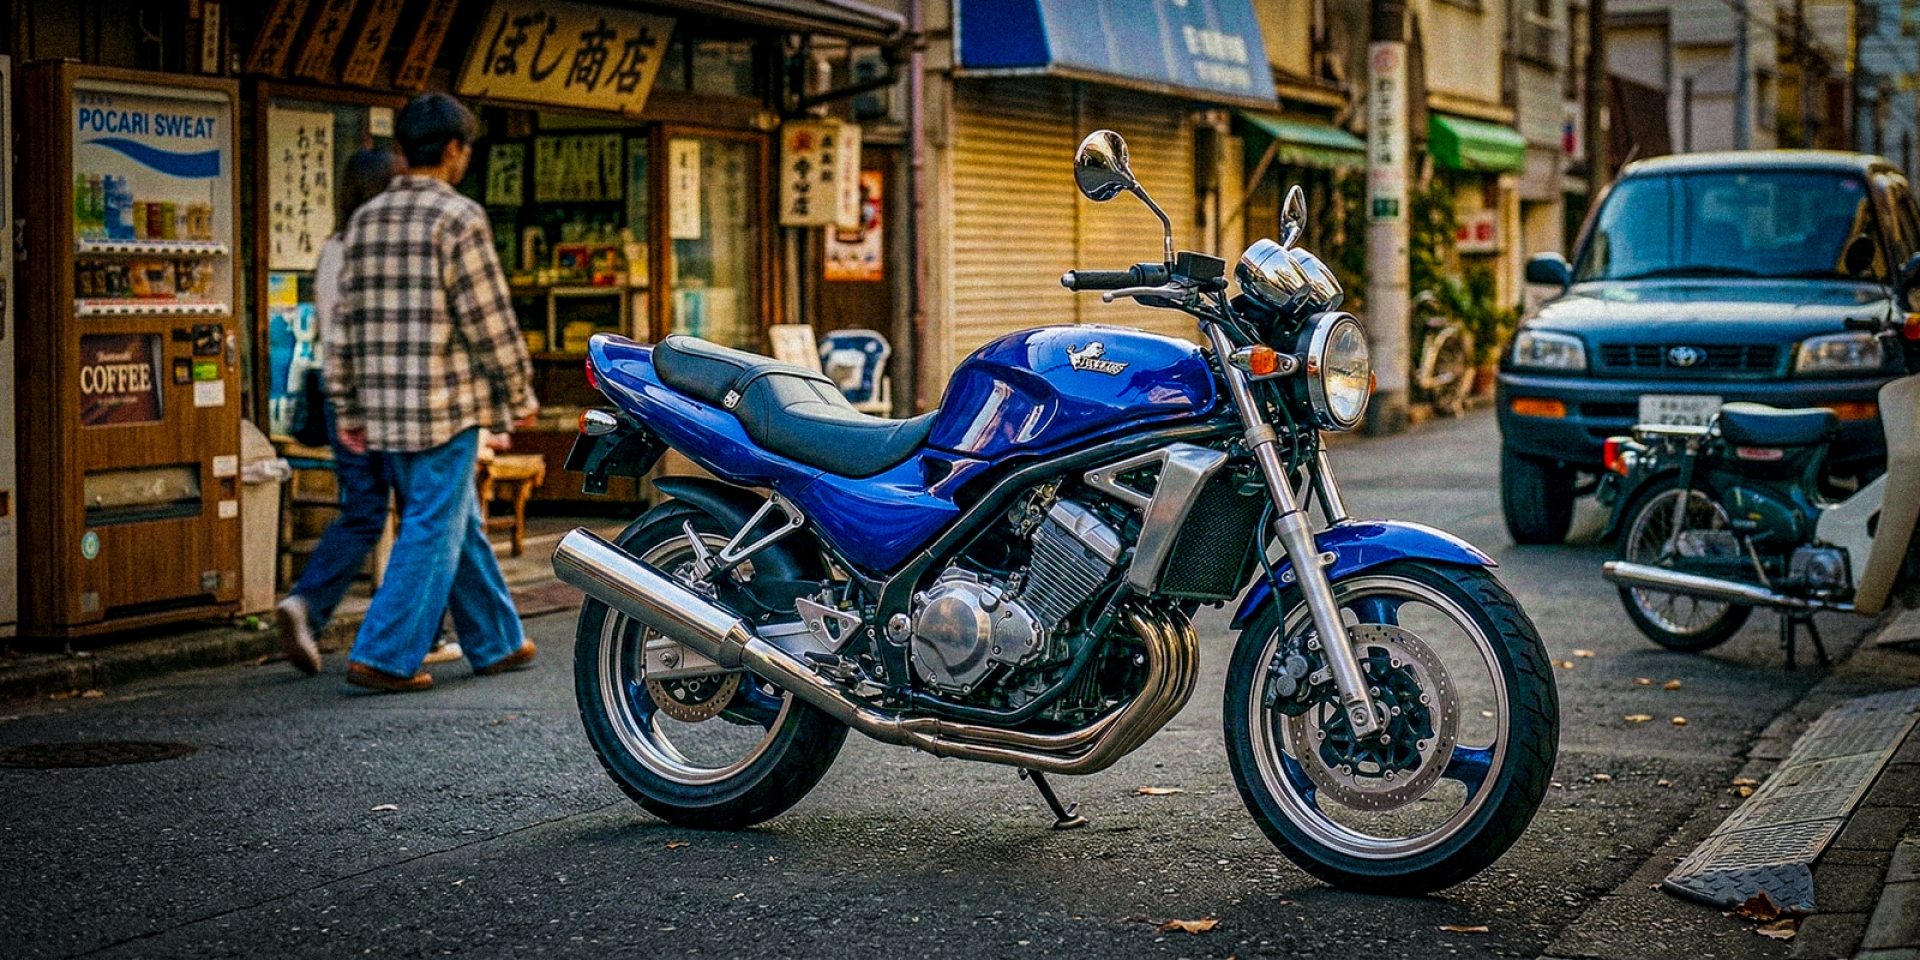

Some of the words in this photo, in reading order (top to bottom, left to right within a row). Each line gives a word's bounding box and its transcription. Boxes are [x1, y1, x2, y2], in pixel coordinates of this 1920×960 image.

[481, 10, 657, 94] ぼし商店
[78, 107, 149, 135] POCARI
[154, 113, 216, 139] SWEAT
[80, 363, 152, 394] COFFEE
